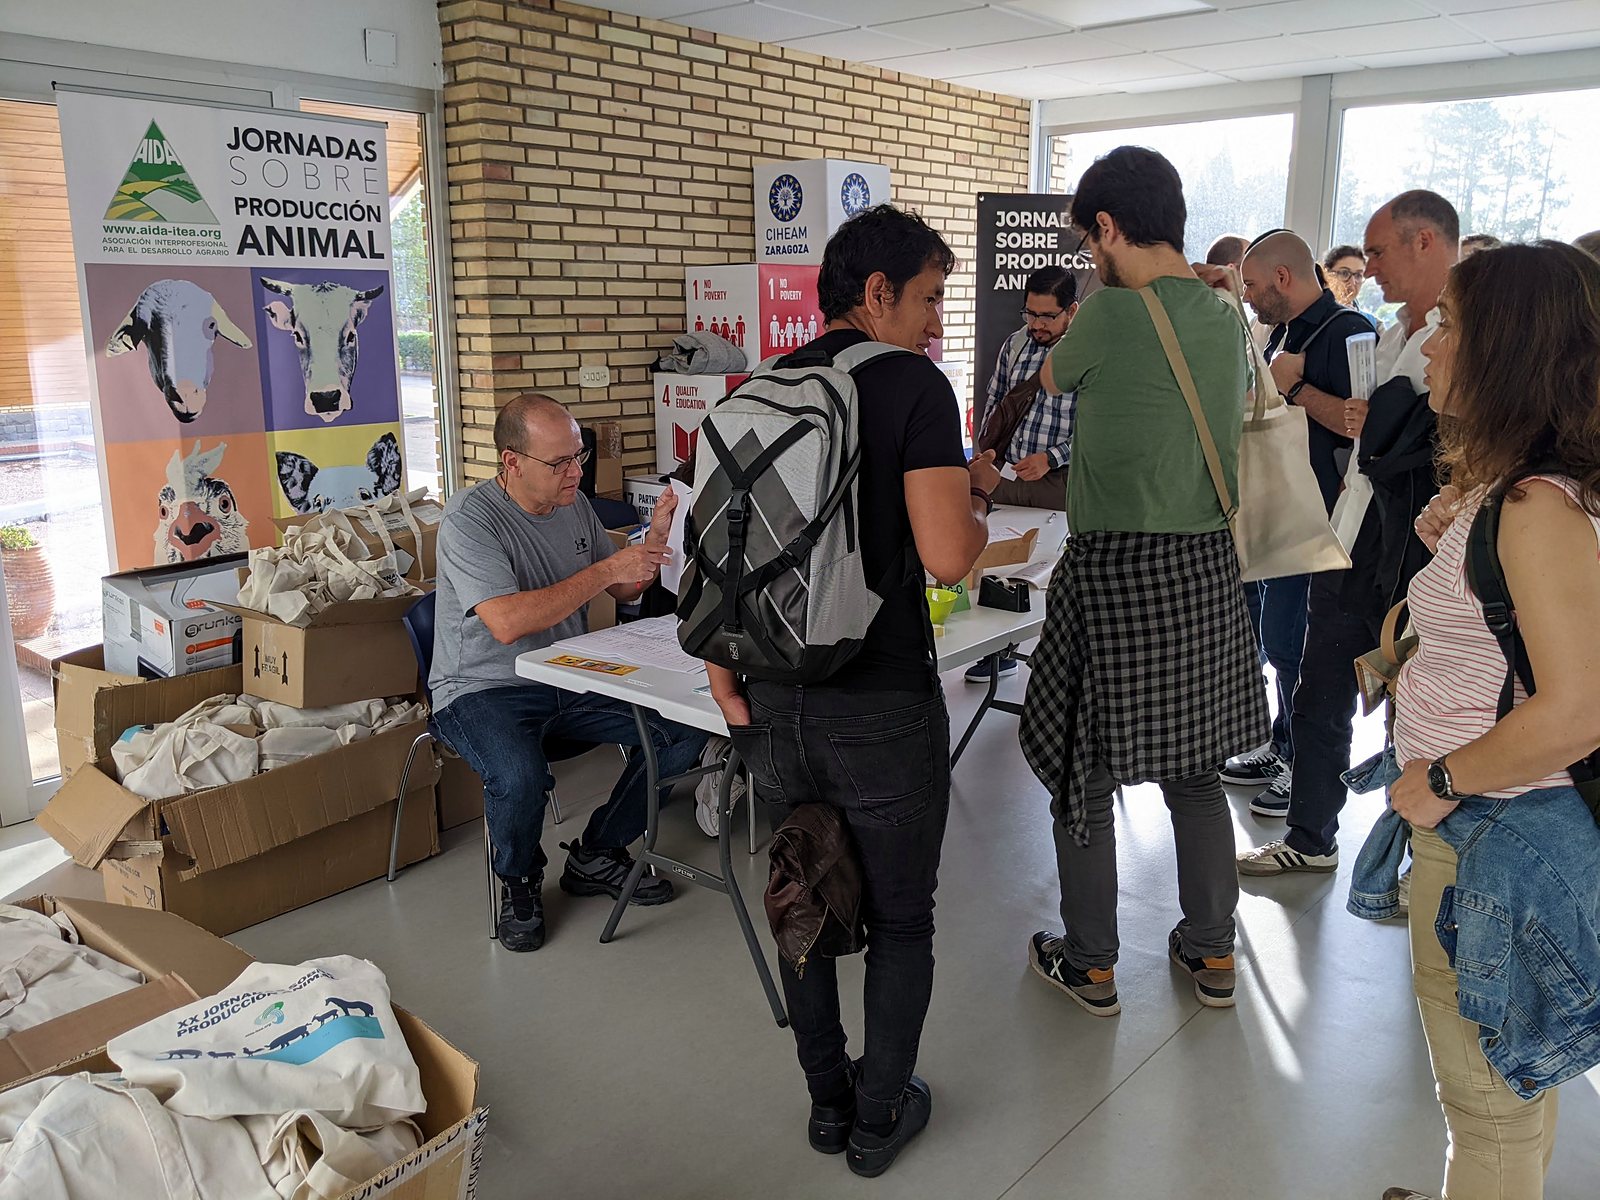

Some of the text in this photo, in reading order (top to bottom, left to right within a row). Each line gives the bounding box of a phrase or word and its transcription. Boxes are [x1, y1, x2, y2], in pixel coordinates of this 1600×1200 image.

[132, 138, 182, 165] AIDA
[226, 126, 378, 162] JORNADAS
[229, 155, 380, 195] SOBRE
[234, 196, 382, 223] PRODUCCIÓN
[995, 210, 1072, 229] JORNAD
[102, 224, 222, 240] www.aida-itea.org
[766, 225, 808, 241] CIHEAM
[102, 236, 229, 248] ASOCIACIÓN INTERPROFESIONAL
[236, 224, 385, 259] ANIMAL
[995, 232, 1058, 249] SOBRE
[103, 245, 230, 257] PARA EL DESARROLLO AGRARIO
[765, 243, 810, 256] ZARAGOZA
[692, 279, 699, 301] 1
[703, 279, 712, 289] NO
[768, 277, 775, 300] 1
[779, 278, 788, 289] NO
[703, 290, 728, 301] POVERTY
[780, 290, 802, 301] POVERTY
[662, 384, 671, 407] 4
[675, 385, 699, 397] QUALITY
[675, 398, 707, 410] EDUCATION
[177, 1014, 200, 1029] XX
